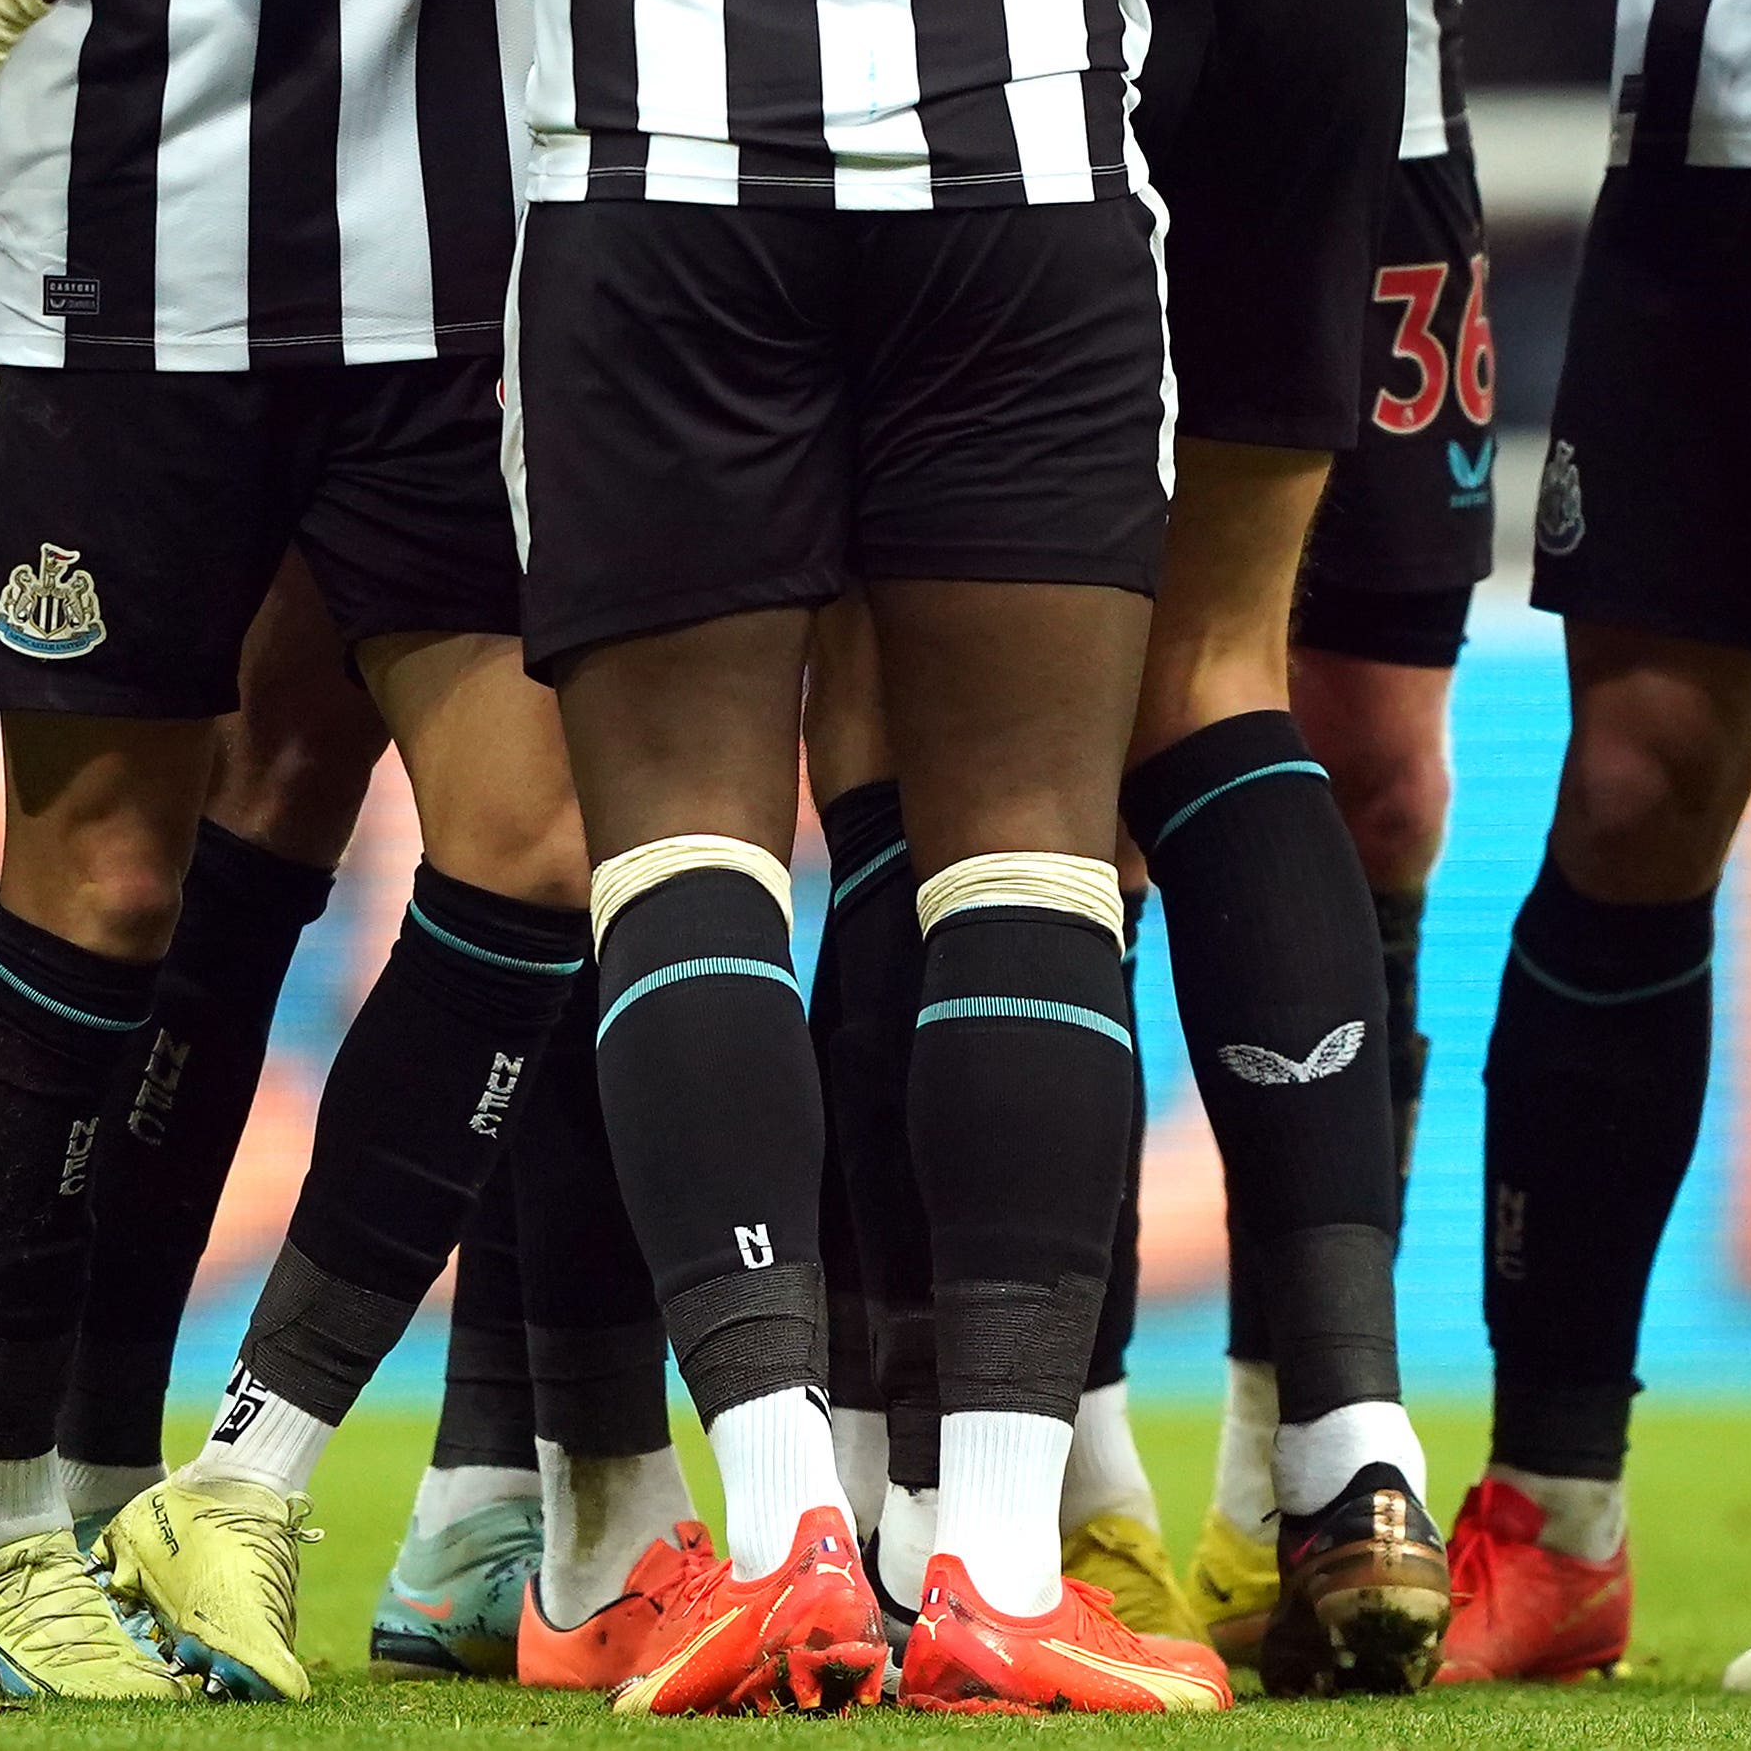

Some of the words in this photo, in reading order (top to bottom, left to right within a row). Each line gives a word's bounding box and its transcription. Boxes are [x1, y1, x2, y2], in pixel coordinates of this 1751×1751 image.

[1371, 254, 1495, 434] 36
[469, 1052, 525, 1139] NUFC
[59, 1117, 100, 1196] NUFC
[151, 1493, 179, 1558] ULTRA
